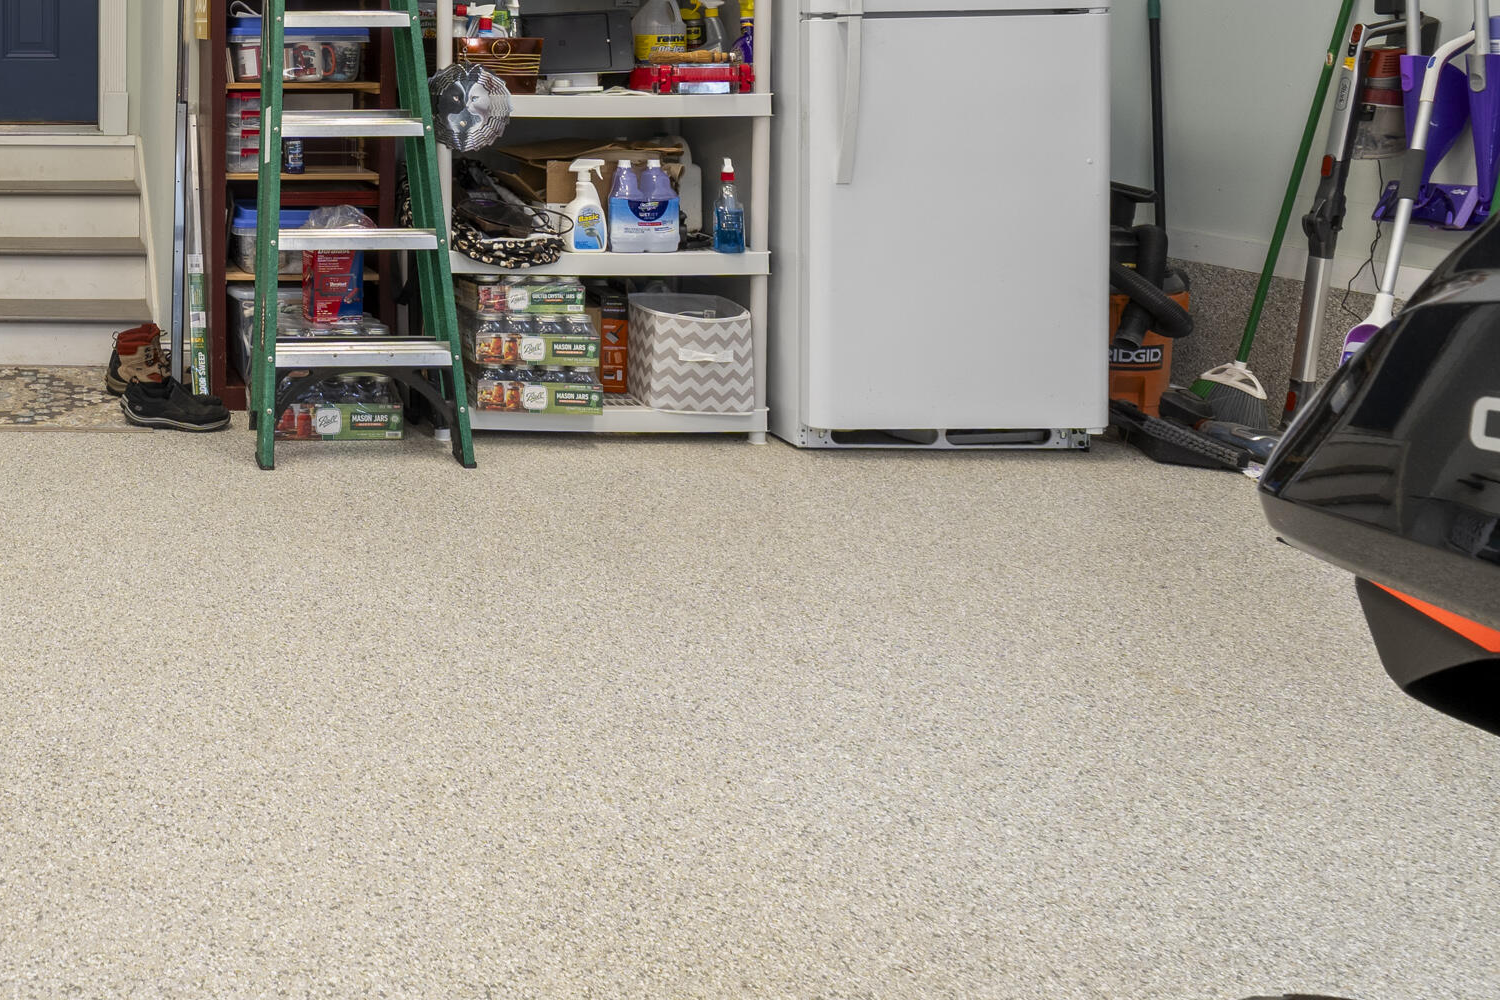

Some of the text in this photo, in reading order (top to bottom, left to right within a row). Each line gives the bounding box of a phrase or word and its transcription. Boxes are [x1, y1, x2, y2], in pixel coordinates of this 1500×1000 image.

[556, 392, 575, 400] MASON
[351, 414, 389, 422] MASON JARS
